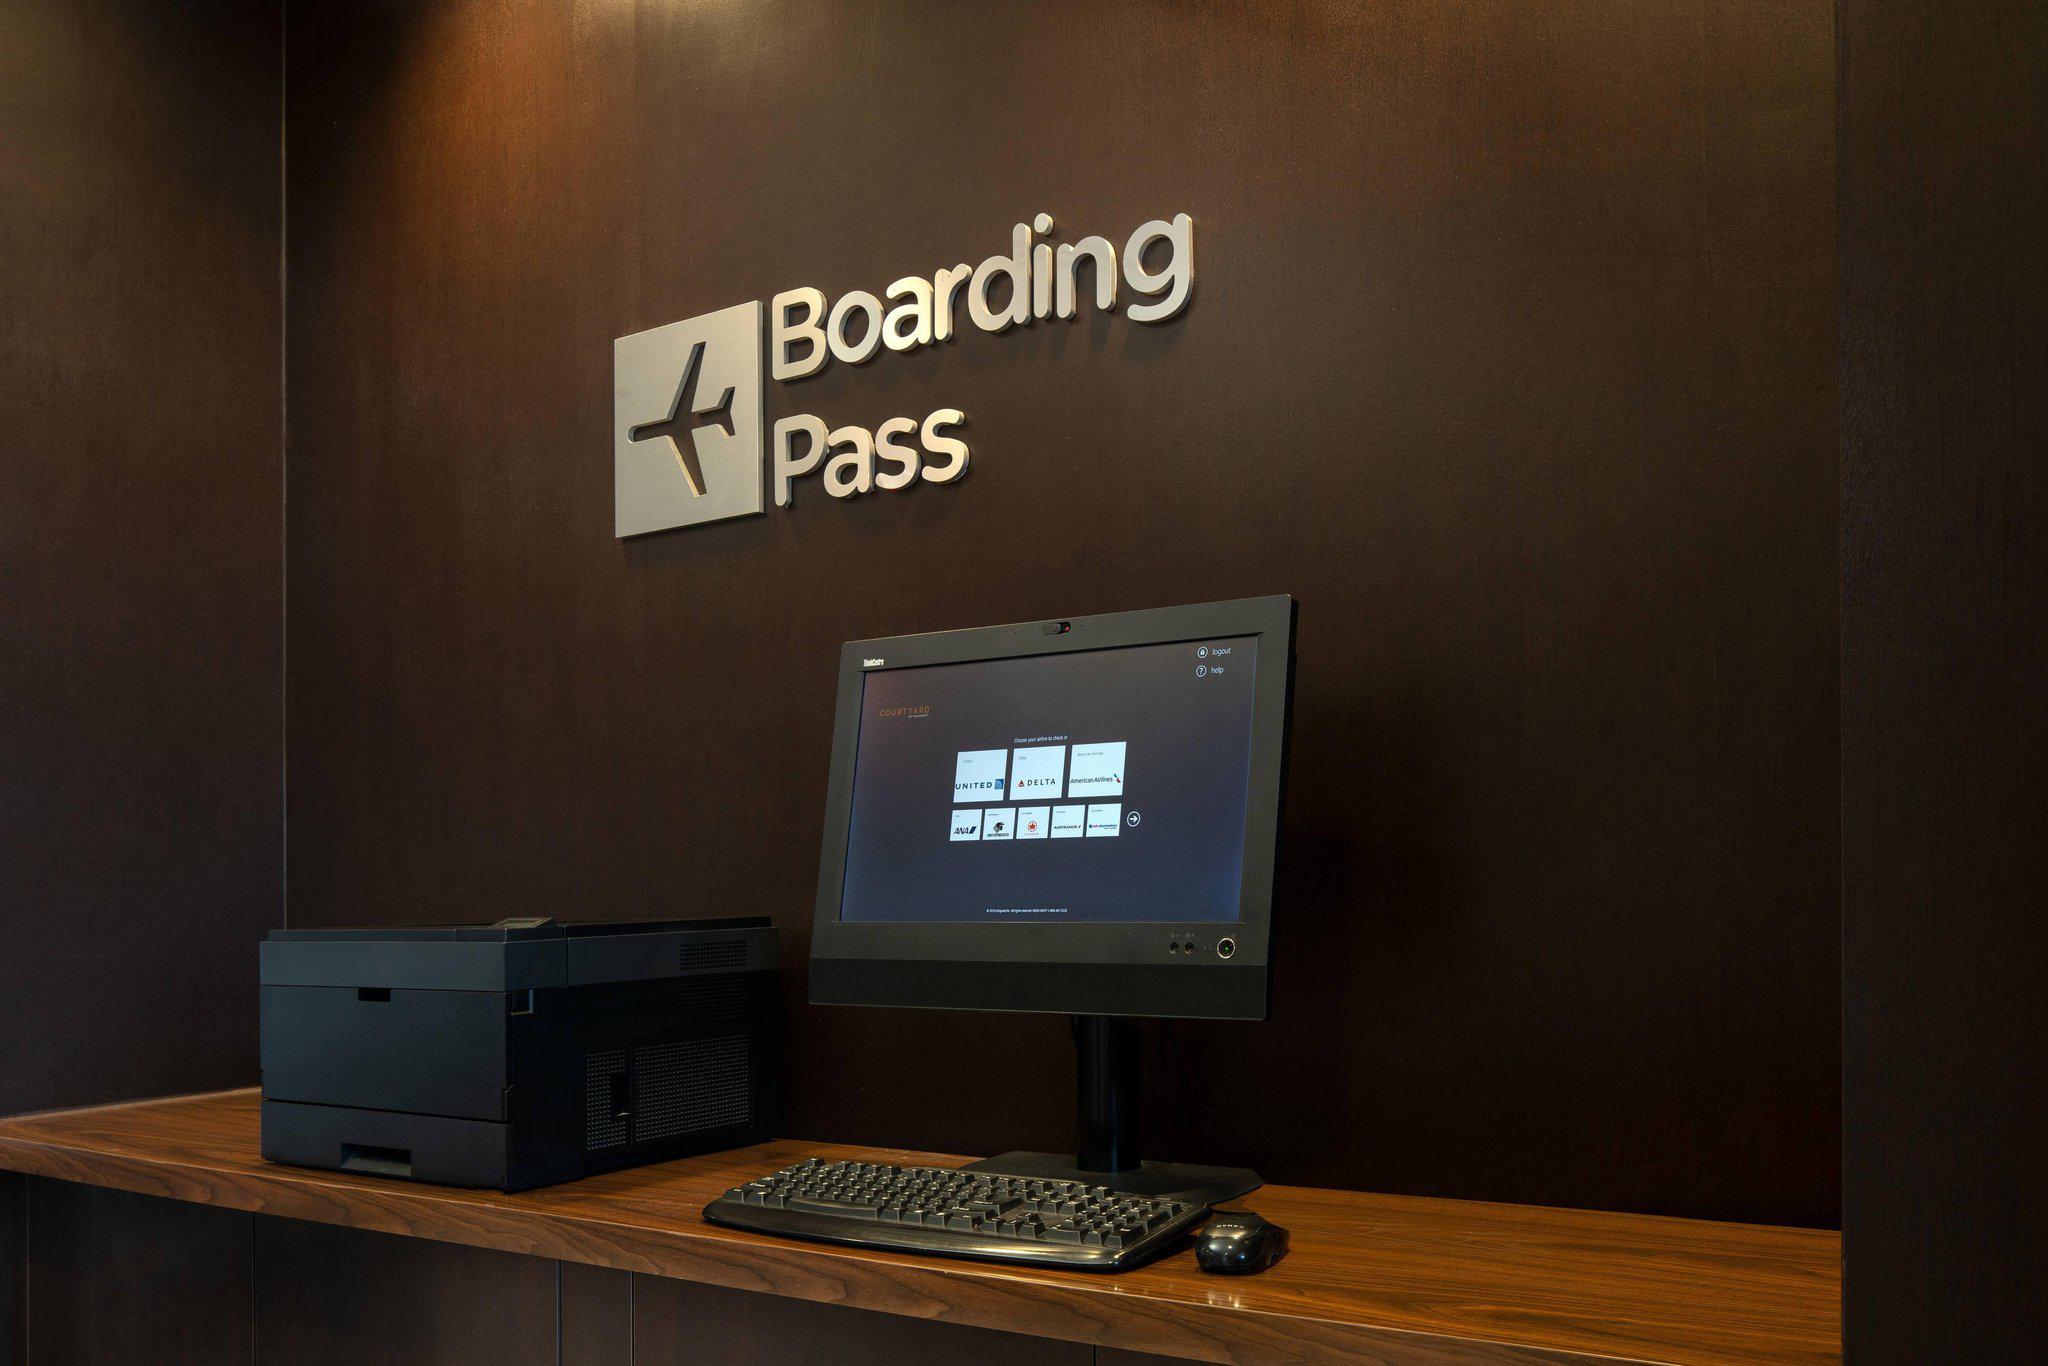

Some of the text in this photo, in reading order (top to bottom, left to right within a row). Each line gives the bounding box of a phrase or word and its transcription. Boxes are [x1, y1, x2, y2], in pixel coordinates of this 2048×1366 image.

[772, 212, 1194, 382] Boarding
[774, 409, 969, 508] Pass
[1212, 647, 1231, 657] logout
[1211, 666, 1225, 674] help
[879, 706, 930, 717] COURTYARD
[955, 781, 993, 790] UNITED
[1027, 778, 1056, 786] DELTA
[953, 827, 969, 835] ANA
